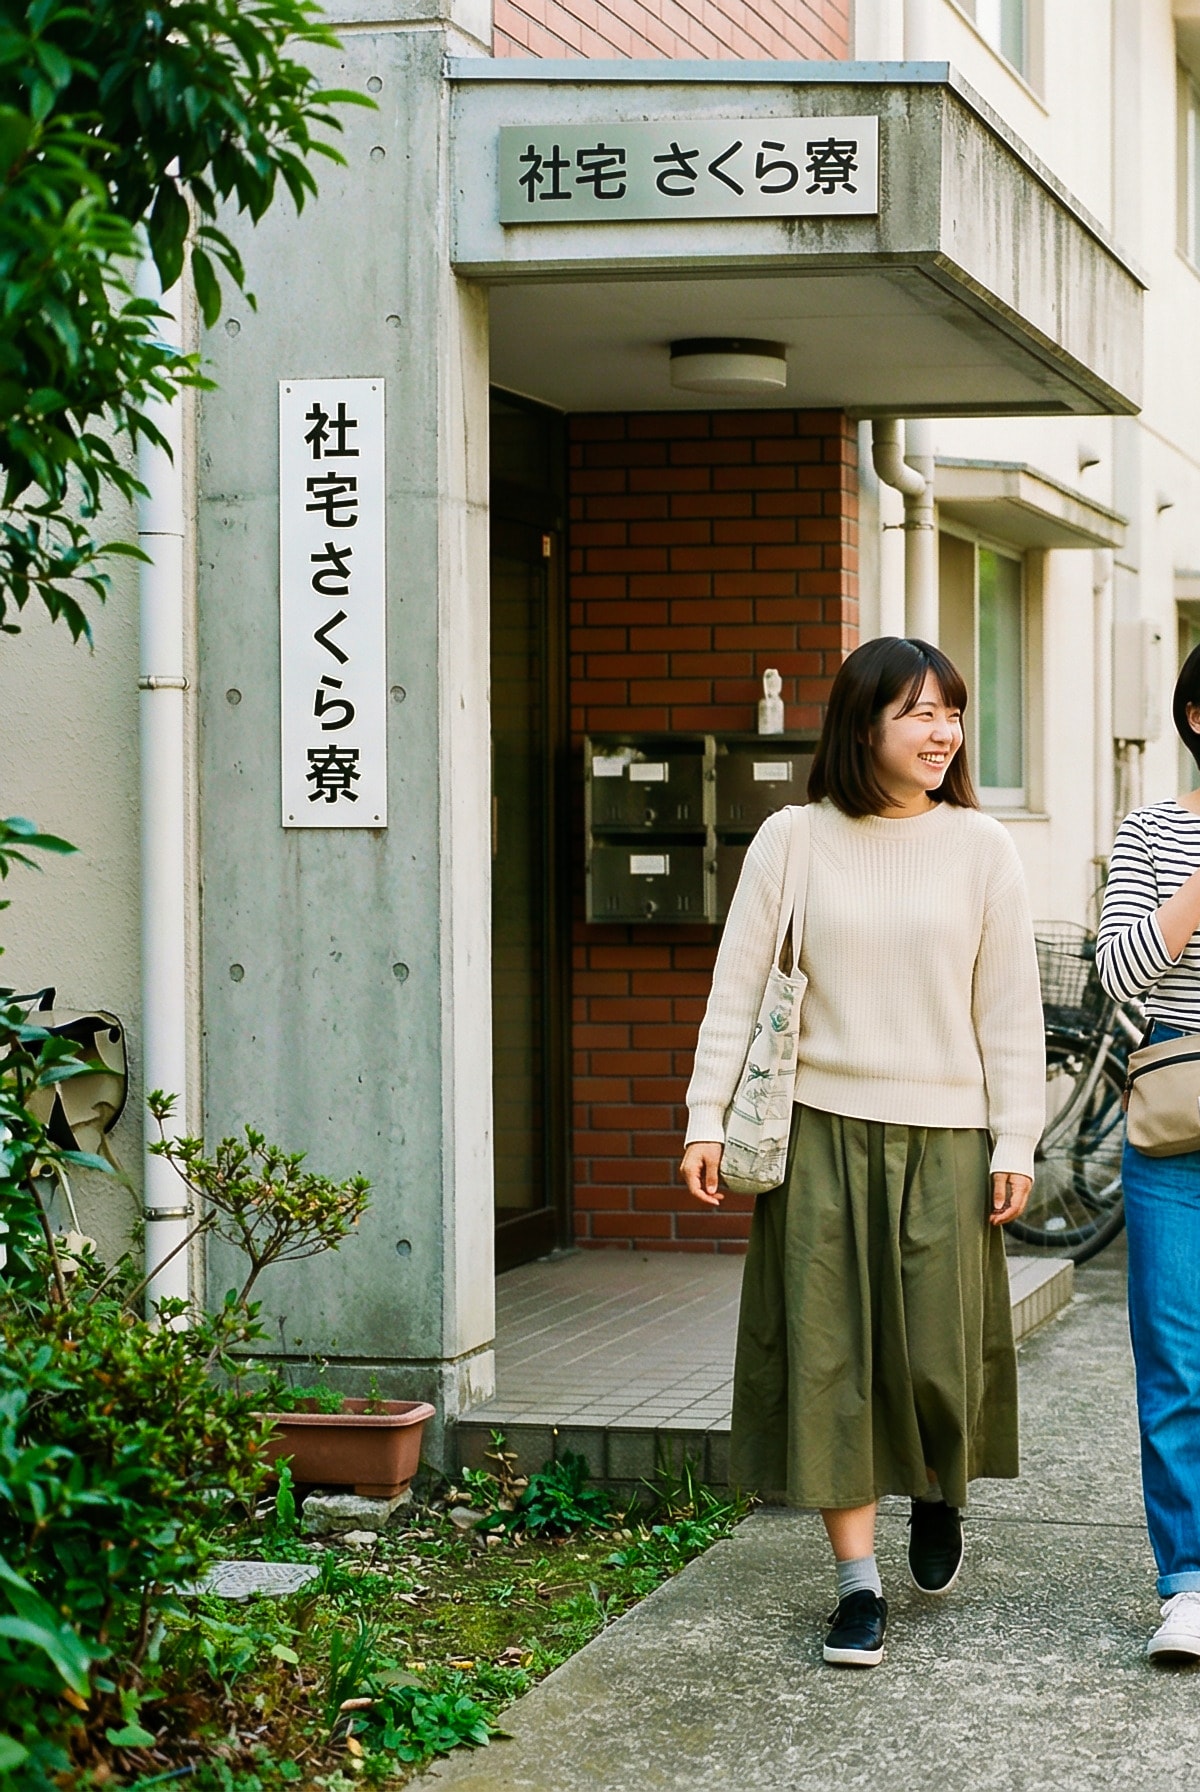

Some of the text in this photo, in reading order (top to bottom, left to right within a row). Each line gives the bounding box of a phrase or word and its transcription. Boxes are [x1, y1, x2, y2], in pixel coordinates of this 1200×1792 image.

[518, 137, 858, 203] 社宅 さくら寮
[304, 402, 361, 804] 社宅さくら寮
